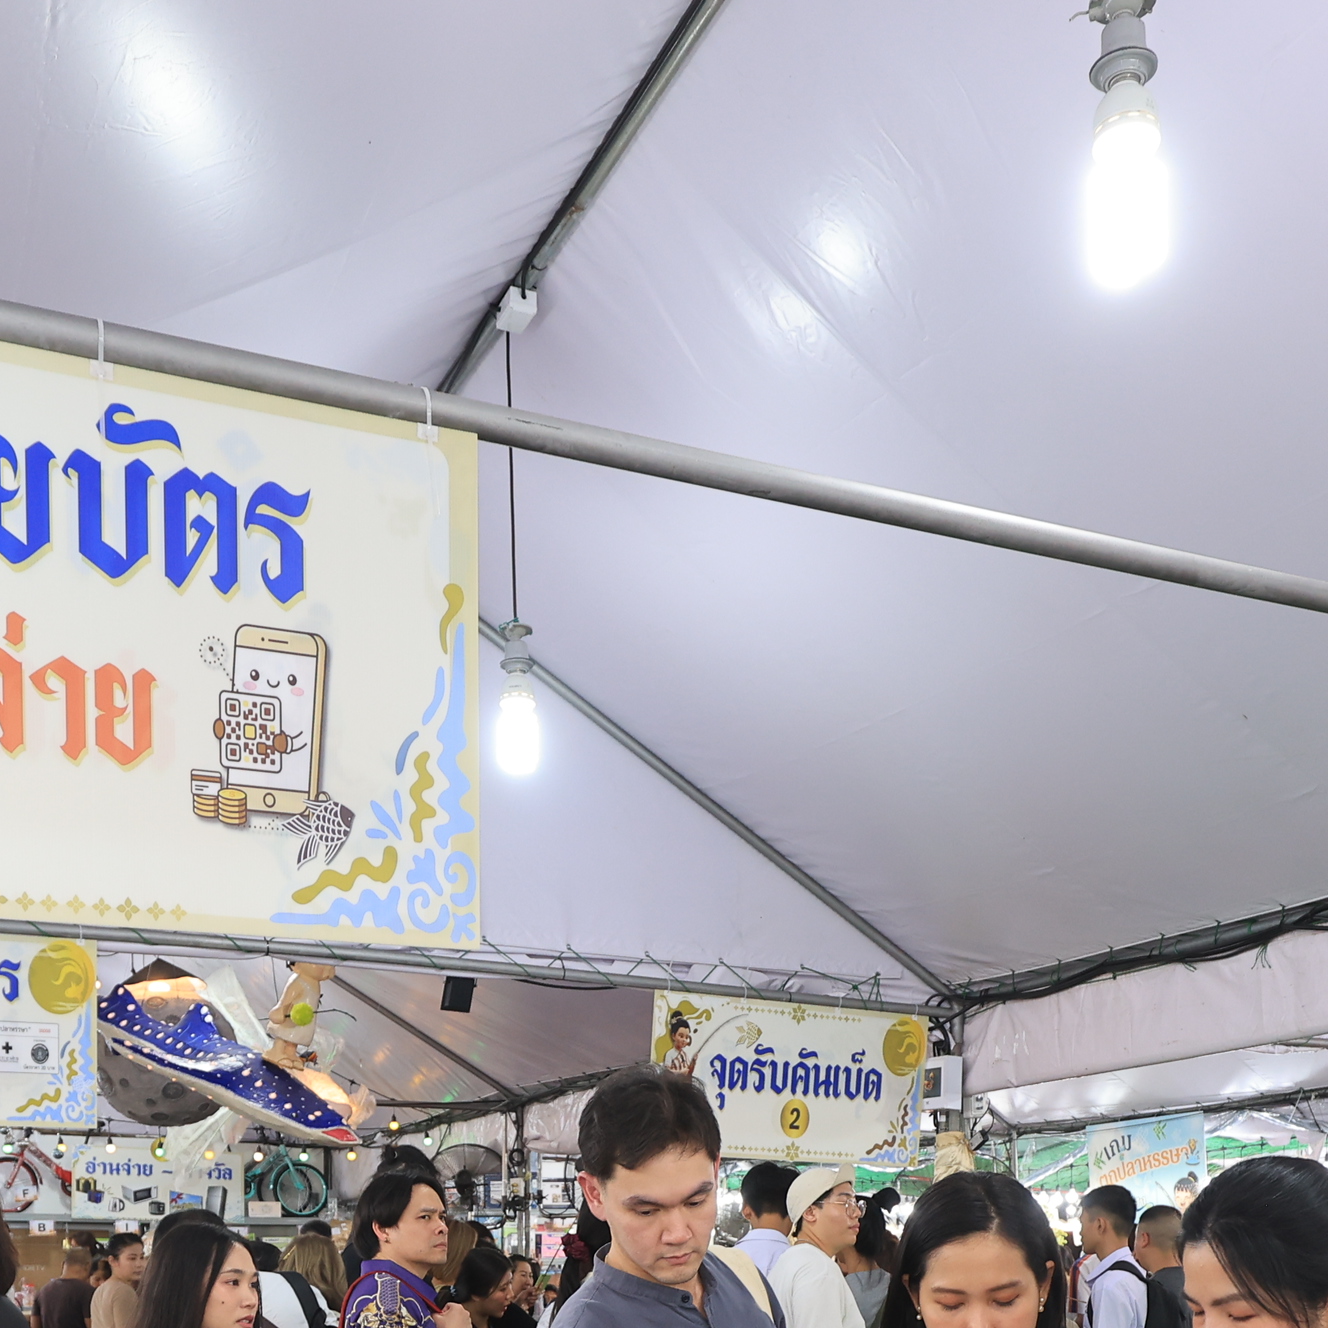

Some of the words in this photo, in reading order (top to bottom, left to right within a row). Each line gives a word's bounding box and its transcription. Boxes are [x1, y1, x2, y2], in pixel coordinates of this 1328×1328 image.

[709, 1043, 883, 1111] จุดรับคันเบ็ด
[788, 1107, 801, 1130] 2
[22, 1188, 29, 1198] F
[38, 1223, 46, 1232] B
